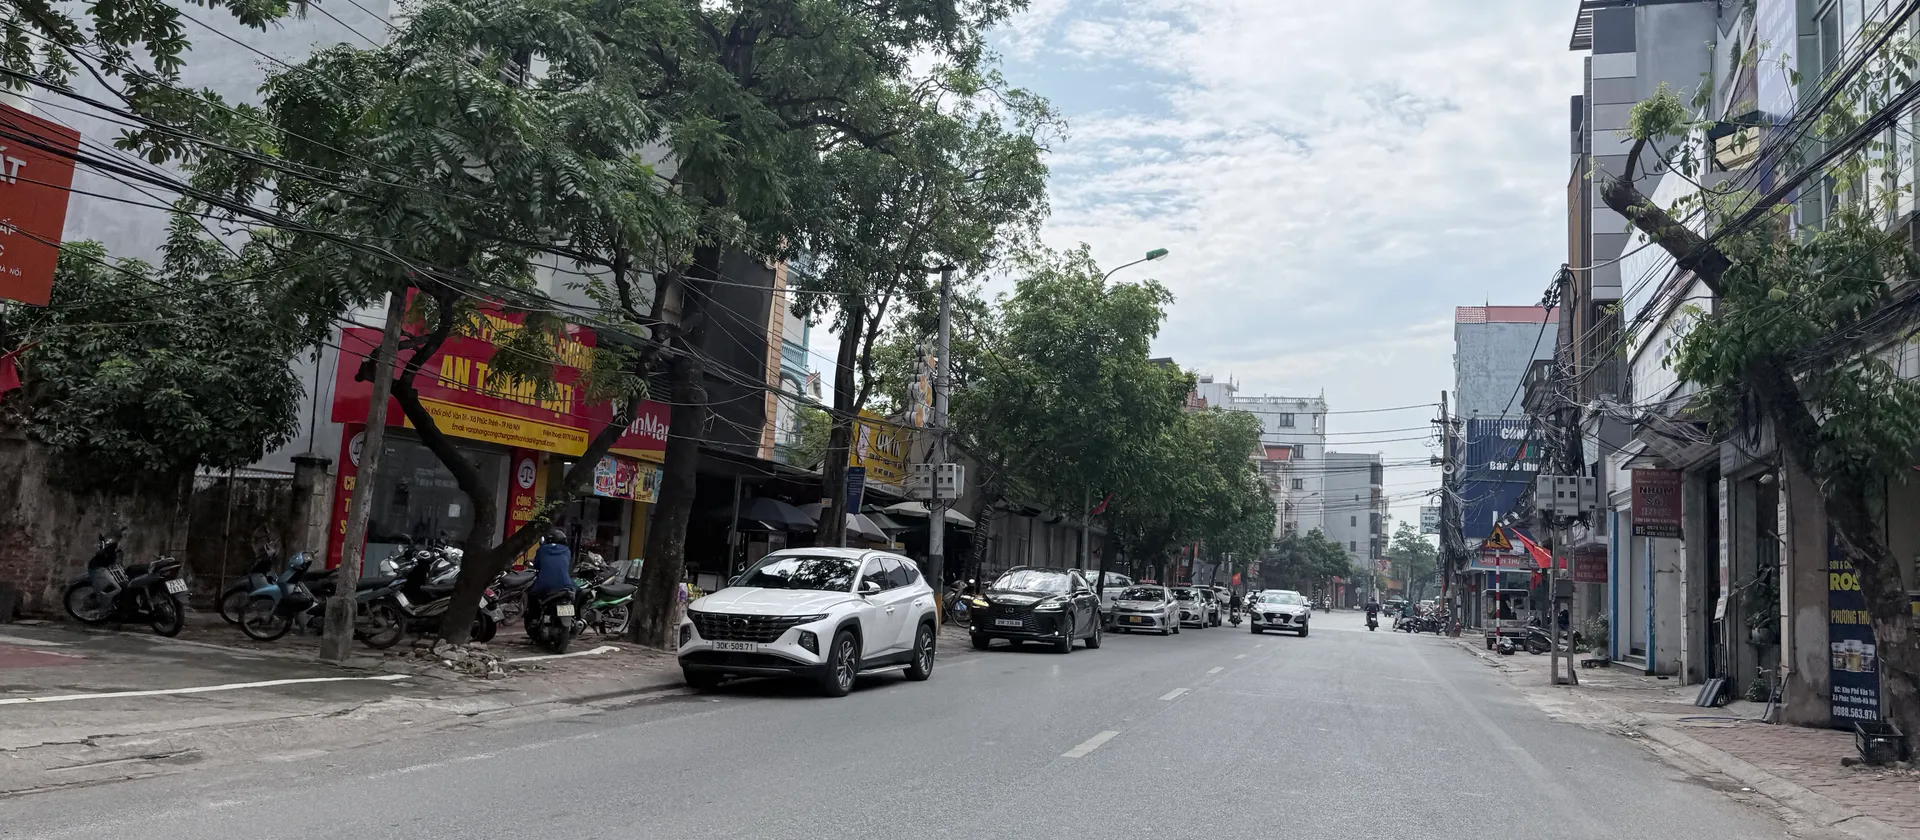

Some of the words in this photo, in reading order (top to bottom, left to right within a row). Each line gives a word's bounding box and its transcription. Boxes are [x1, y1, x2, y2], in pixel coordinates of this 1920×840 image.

[437, 355, 471, 392] AN
[475, 361, 537, 406] TNH
[1480, 557, 1507, 565] CHUYN
[1829, 572, 1861, 591] ROS
[1832, 705, 1877, 721] 0988.563.974
